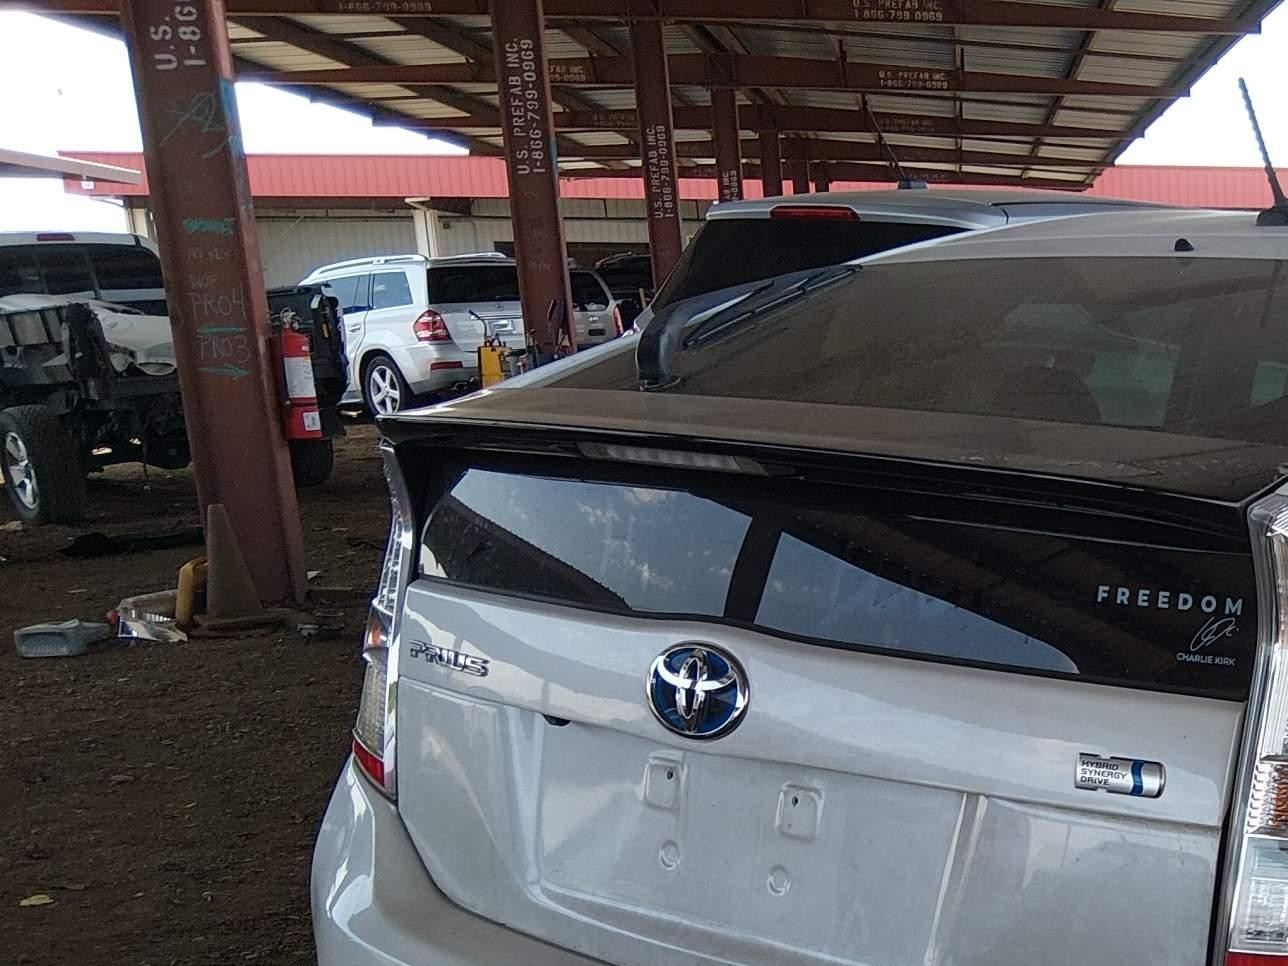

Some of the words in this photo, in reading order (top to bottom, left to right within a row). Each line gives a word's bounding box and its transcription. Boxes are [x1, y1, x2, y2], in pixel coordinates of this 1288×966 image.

[150, 16, 179, 70] U.S.
[174, 0, 207, 66] 1-86
[505, 37, 520, 68] INC.
[508, 76, 527, 136] PREFAB
[516, 145, 531, 175] U.S.
[648, 150, 661, 193] PREFAB
[1097, 585, 1243, 616] FREEDOM
[409, 640, 490, 677] PRIUS
[1176, 652, 1213, 665] CHARLIE
[1214, 655, 1236, 667] KIRK
[1080, 768, 1127, 780] SYNERGY
[1081, 760, 1119, 770] HYBRID
[1080, 776, 1110, 786] DRIVE
